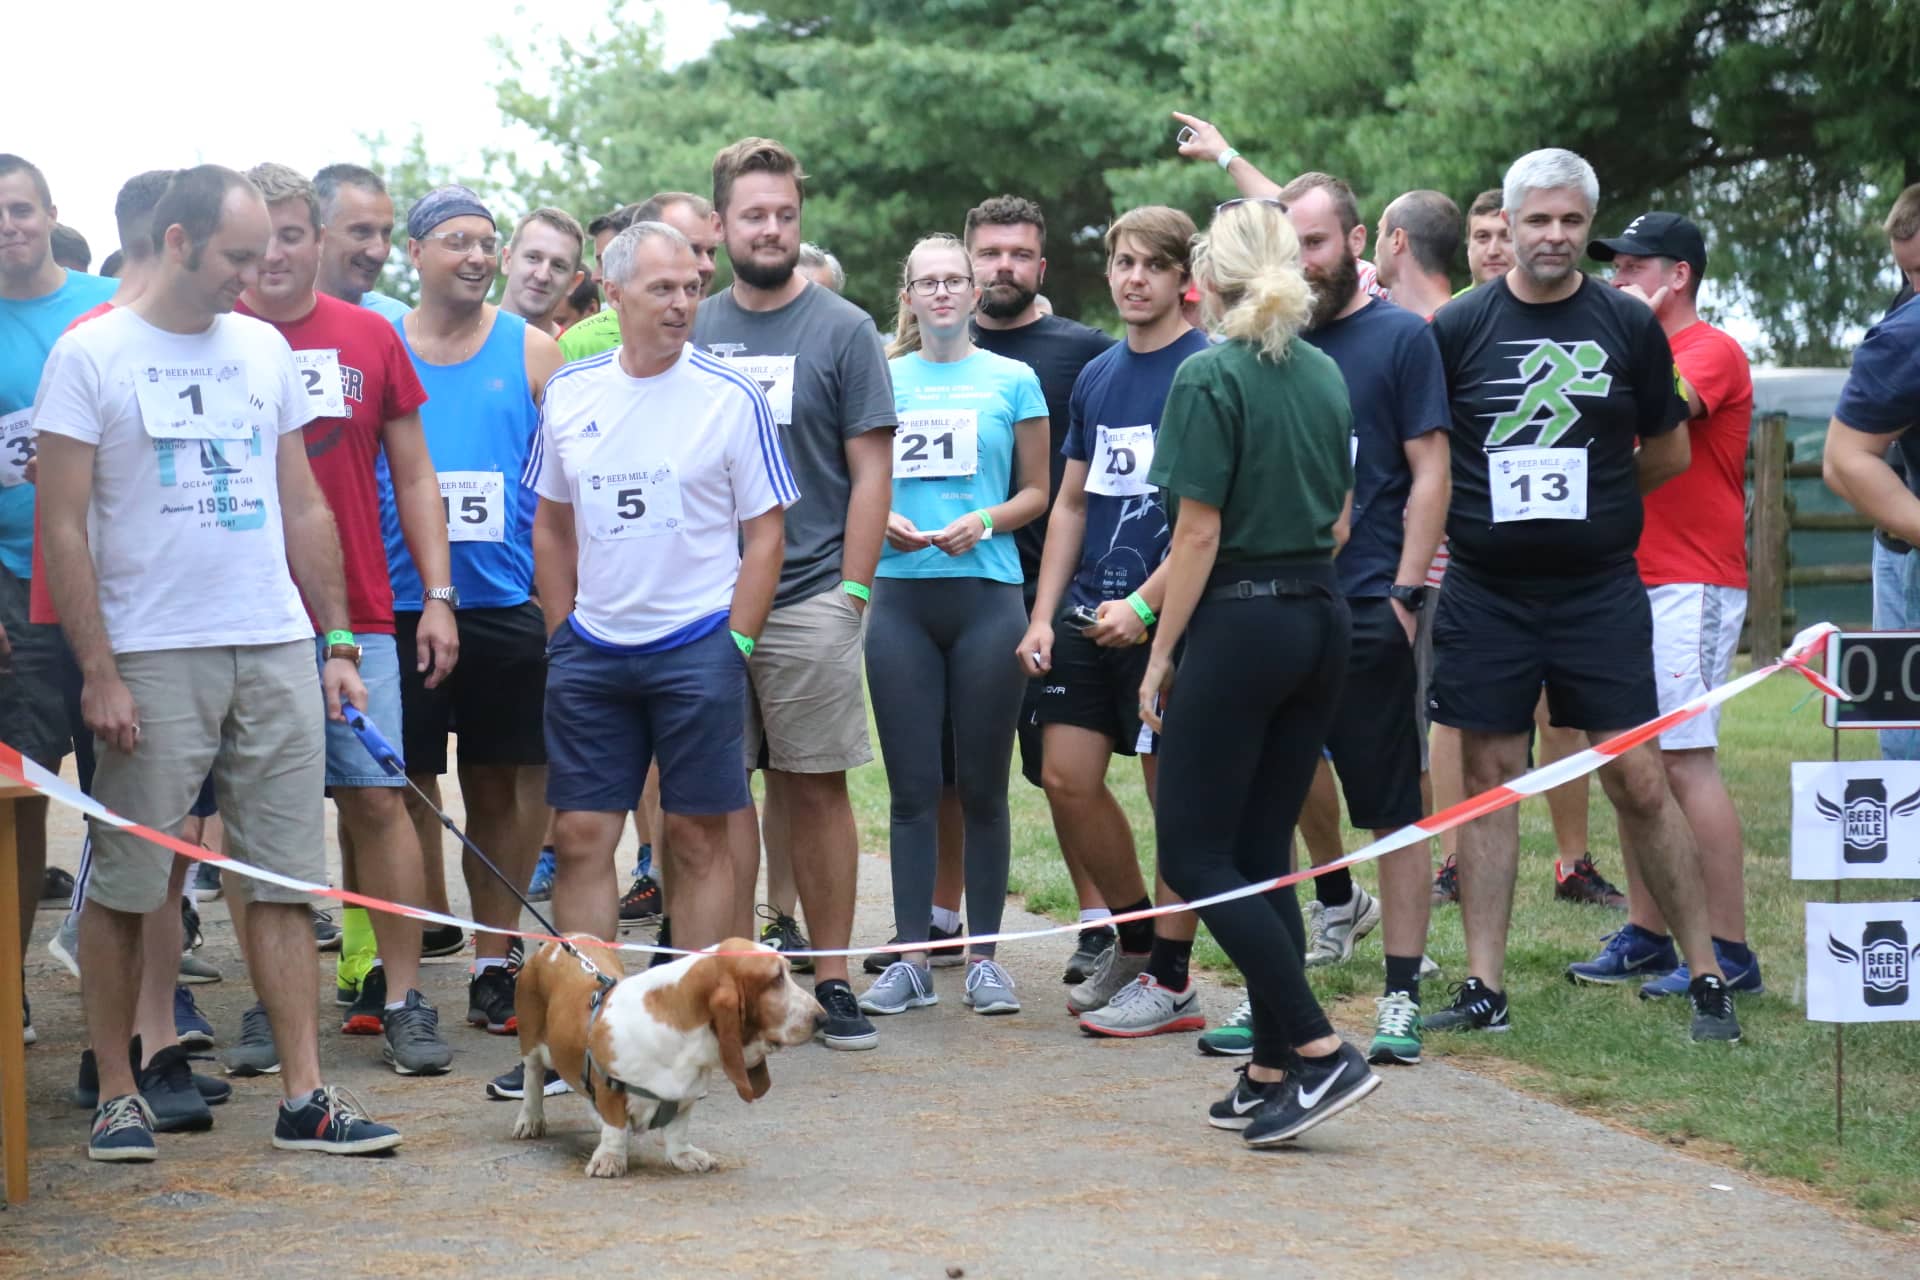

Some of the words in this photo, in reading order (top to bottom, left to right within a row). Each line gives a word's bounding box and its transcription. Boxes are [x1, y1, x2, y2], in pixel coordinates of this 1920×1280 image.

[165, 368, 188, 377] BEER
[190, 367, 213, 376] MILE
[301, 369, 324, 395] 2
[178, 384, 204, 415] 1
[910, 419, 929, 428] BEER
[931, 418, 950, 426] MILE
[900, 432, 954, 461] 21
[1105, 446, 1137, 476] 20
[1517, 460, 1537, 468] BEER
[607, 473, 627, 483] BEER
[629, 472, 648, 481] MILE
[459, 481, 478, 489] MILE
[1510, 473, 1570, 503] 13
[198, 495, 238, 515] 1950
[617, 488, 646, 520] 5
[1848, 810, 1882, 822] BEER
[1848, 824, 1882, 836] MILE
[1868, 952, 1904, 966] BEER
[1868, 966, 1904, 979] MILE
